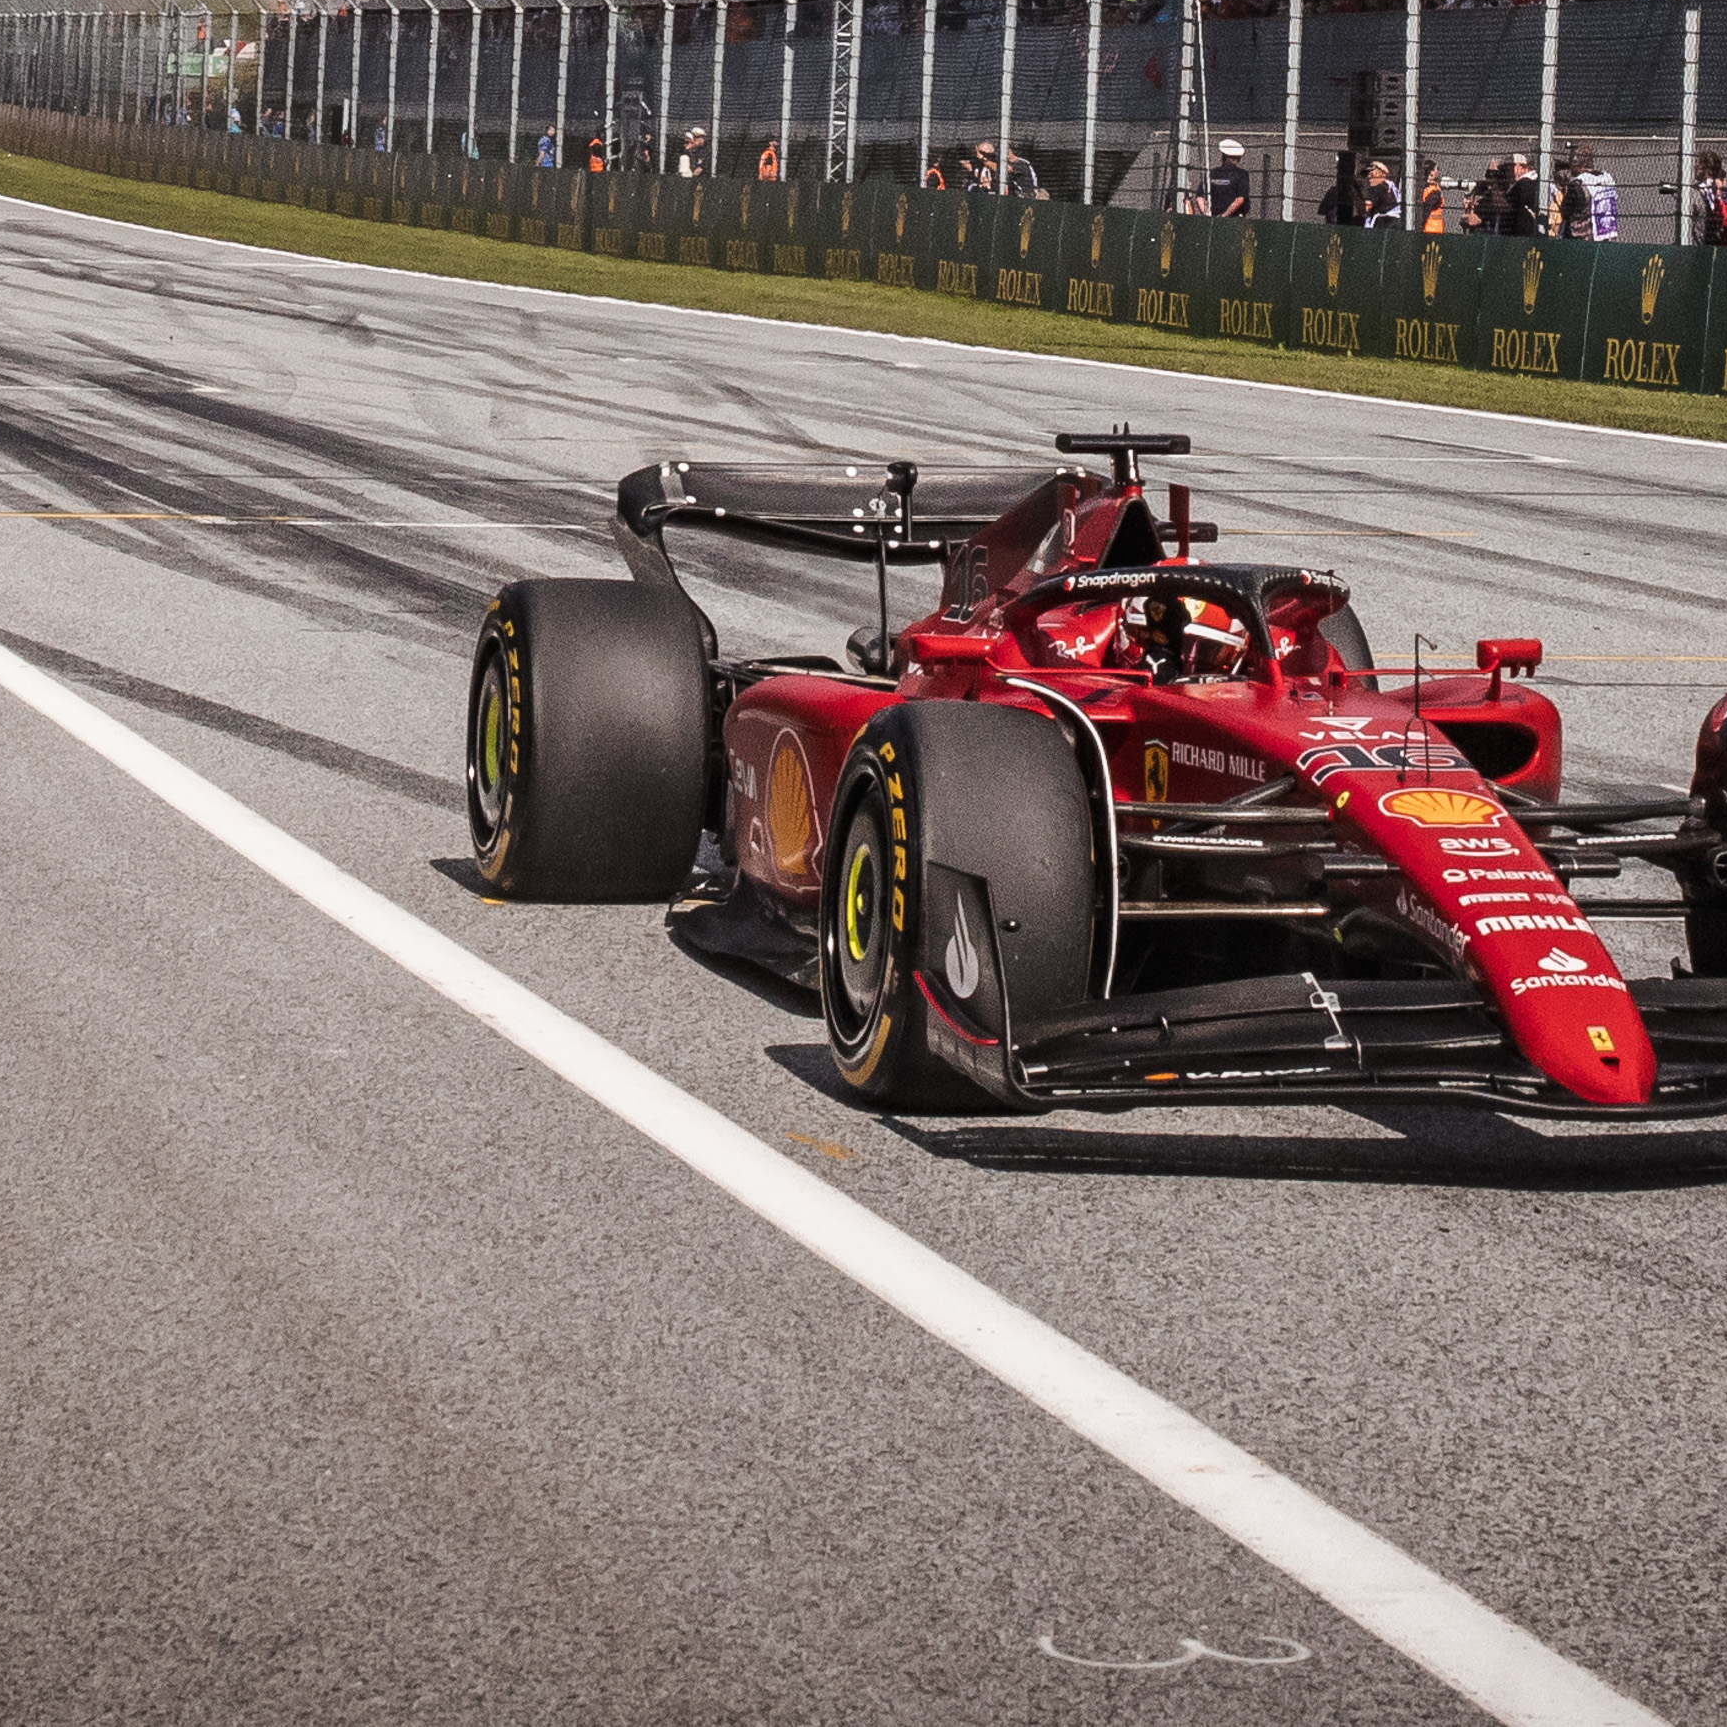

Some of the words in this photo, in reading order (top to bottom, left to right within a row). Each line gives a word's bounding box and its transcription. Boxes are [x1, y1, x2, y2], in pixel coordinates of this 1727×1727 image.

[996, 267, 1042, 306] ROLEX
[1067, 277, 1115, 316] ROLEX
[1137, 288, 1189, 328] ROLEX
[1219, 298, 1273, 339] ROLEX
[1302, 307, 1360, 350] ROLEX
[1396, 318, 1460, 363] ROLEX
[1492, 328, 1561, 373] ROLEX
[1604, 337, 1681, 386] ROLEX
[940, 540, 990, 625] 16
[1077, 572, 1156, 588] Snapdragon
[1171, 740, 1224, 774] RICHARD
[1229, 754, 1266, 783] MILLE
[1295, 743, 1480, 787] 16
[887, 772, 907, 932] ZERO
[1438, 837, 1512, 850] aws
[1509, 973, 1628, 997] Santander
